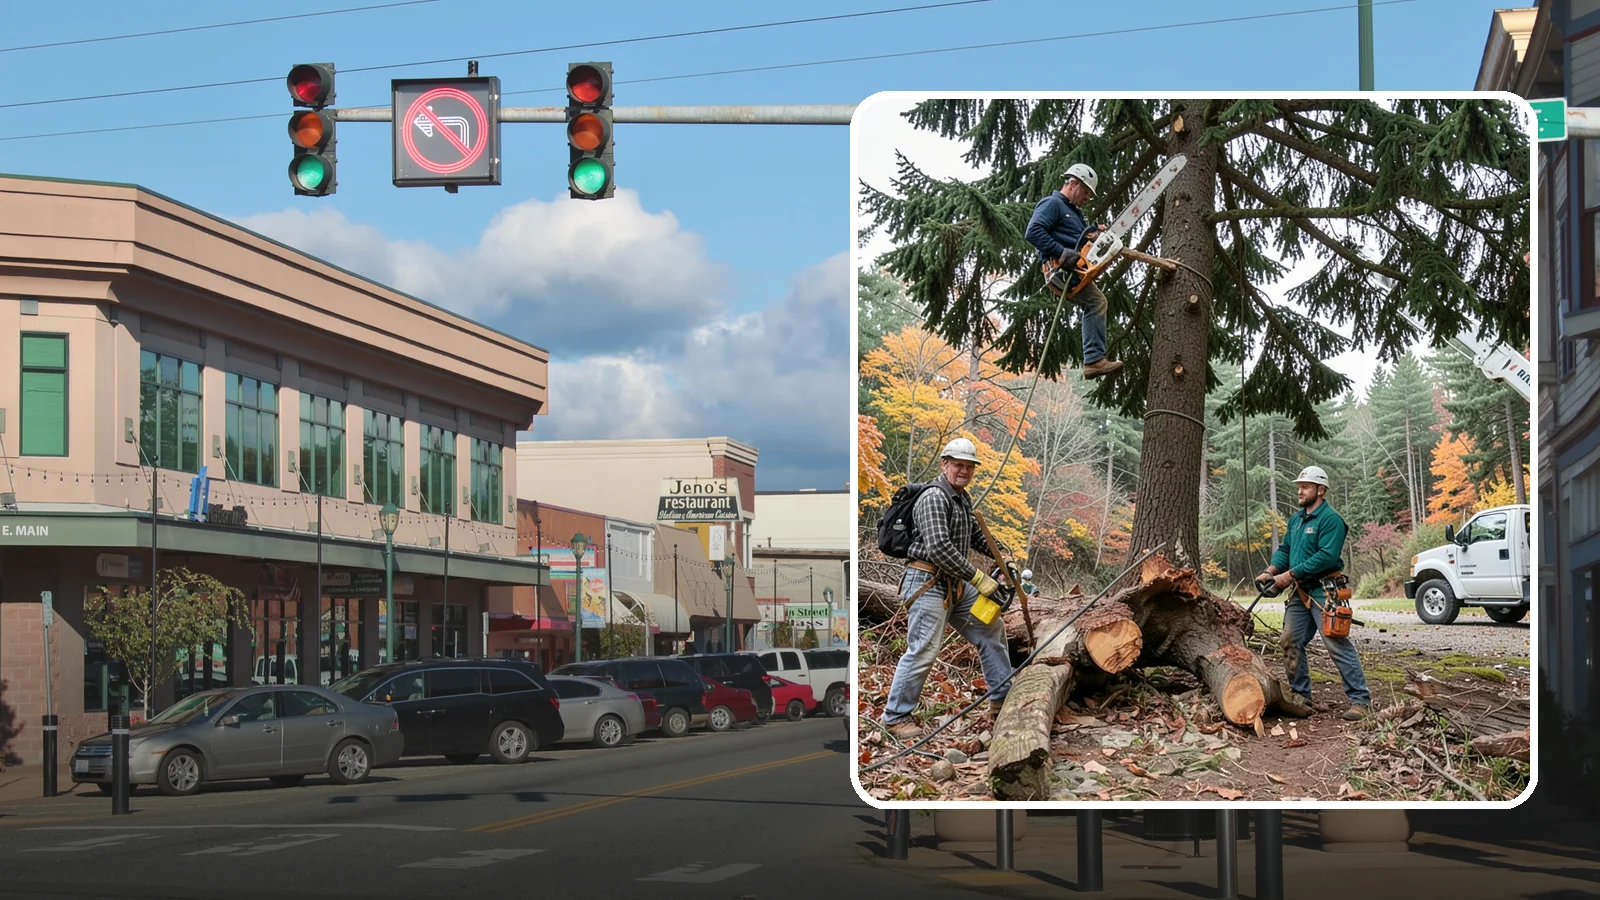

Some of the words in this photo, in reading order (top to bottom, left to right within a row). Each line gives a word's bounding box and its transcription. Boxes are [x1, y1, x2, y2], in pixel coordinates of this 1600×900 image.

[670, 480, 727, 494] Jeno's
[665, 496, 731, 509] restaurant
[686, 509, 714, 519] American
[715, 509, 737, 519] Cuisine
[2, 525, 13, 536] E.
[15, 525, 49, 536] MAIN
[797, 607, 828, 617] Street
[791, 619, 823, 627] lass
